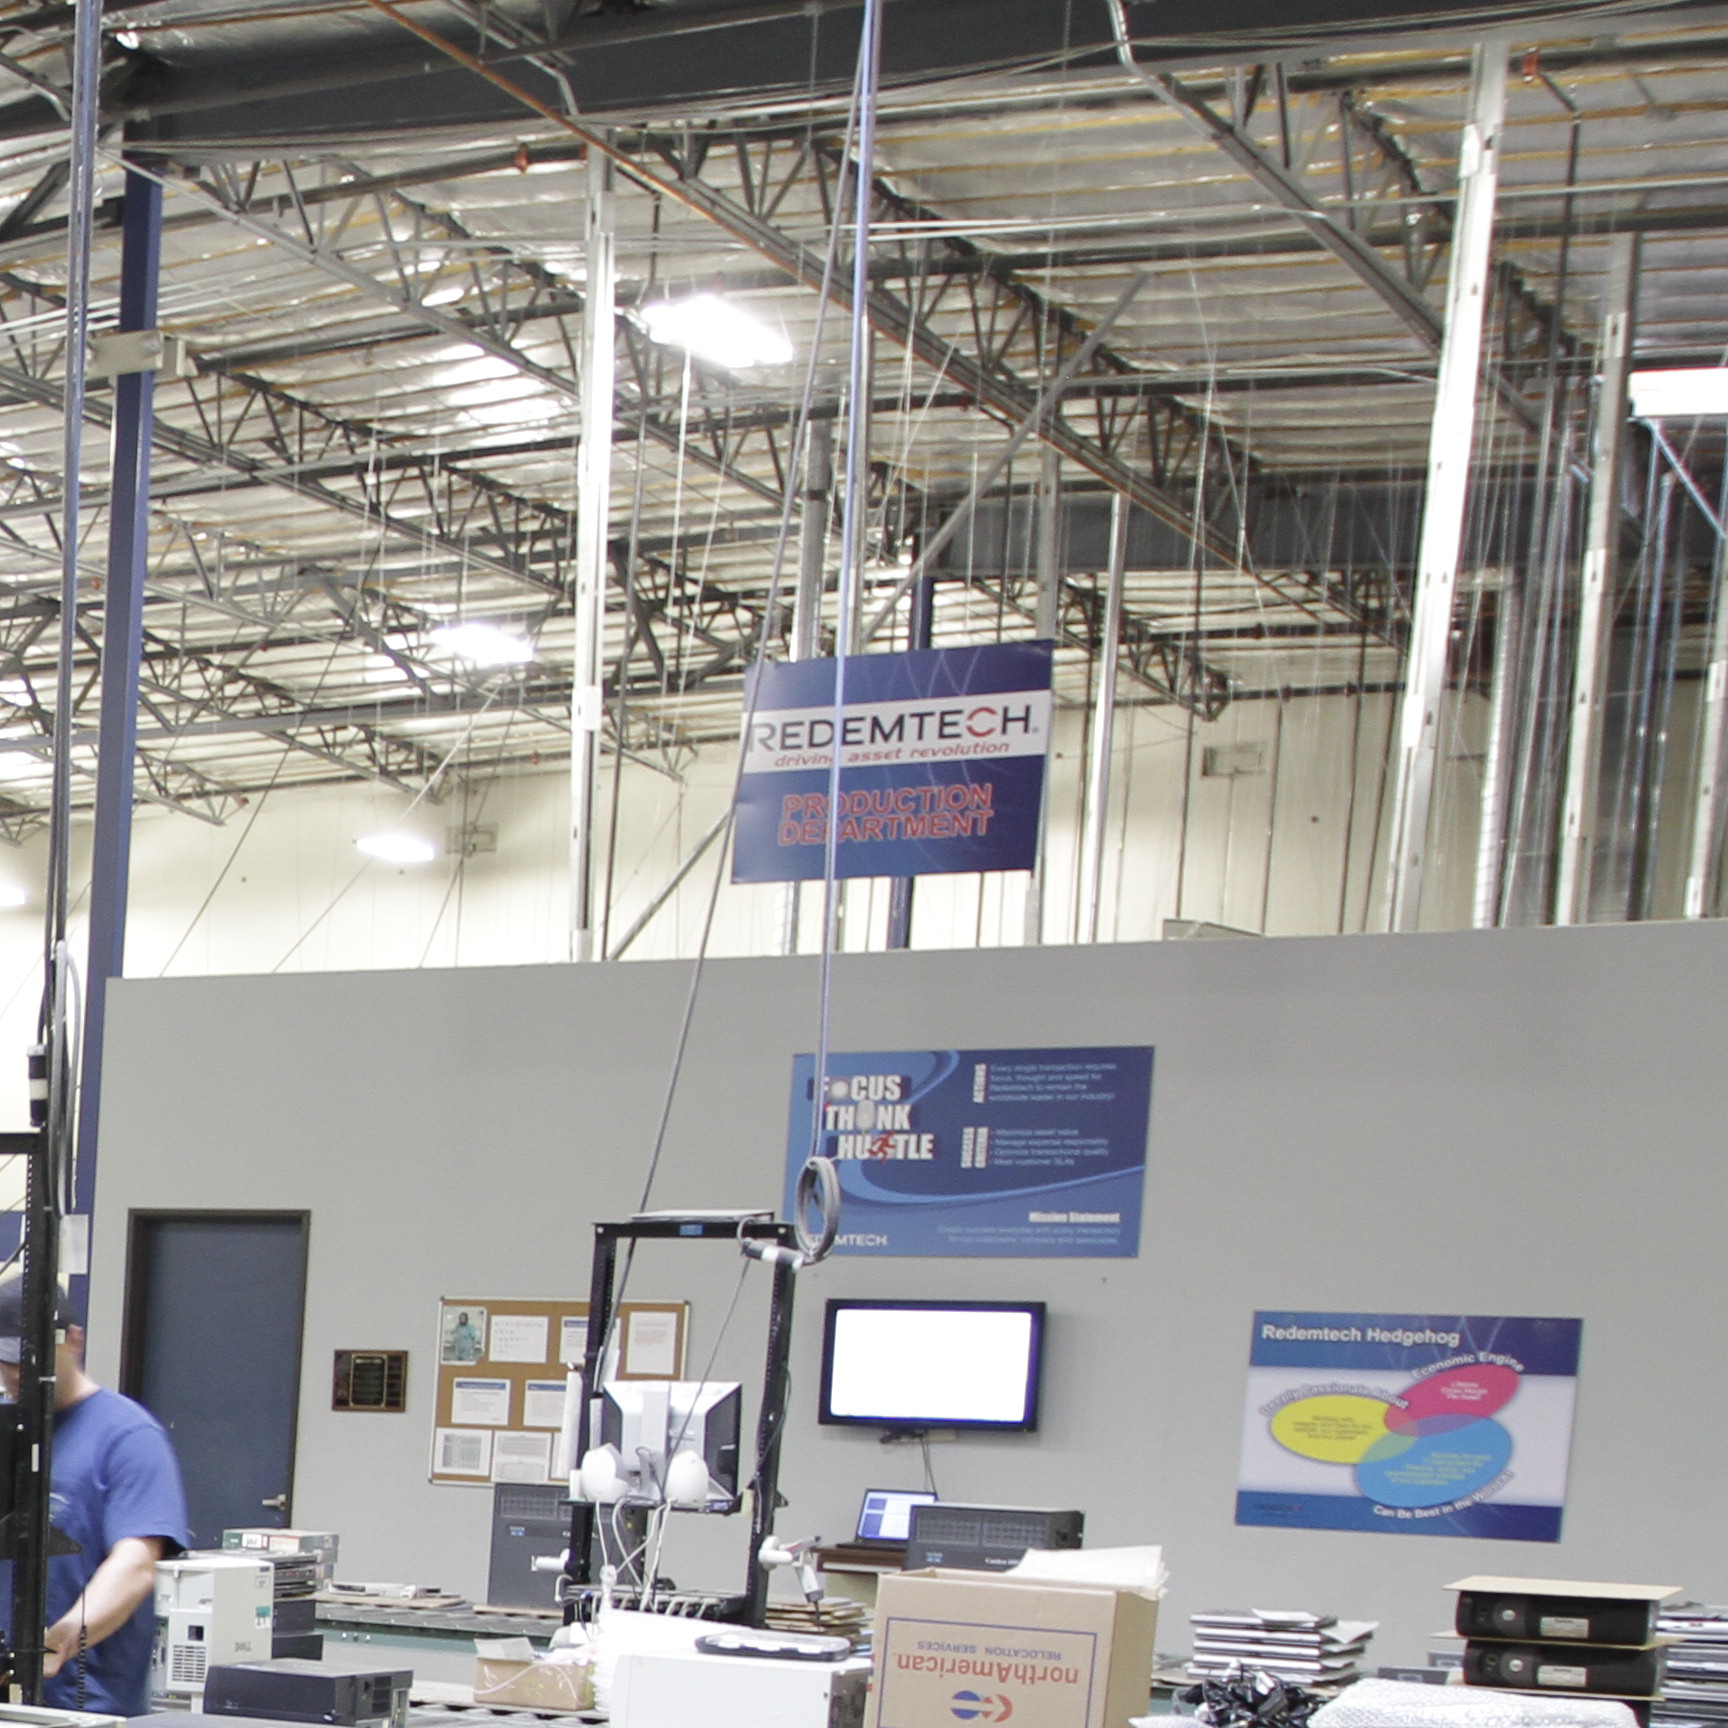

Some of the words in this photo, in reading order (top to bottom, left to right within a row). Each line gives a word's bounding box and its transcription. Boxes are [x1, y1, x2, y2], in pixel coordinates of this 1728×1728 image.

[747, 704, 1032, 752] REDEMTECH
[847, 748, 902, 763] asset
[909, 742, 1011, 760] revolution
[1261, 1323, 1361, 1343] Redemtech
[1366, 1325, 1461, 1348] Hedgehog
[1411, 1352, 1476, 1380] Economic
[1478, 1351, 1525, 1373] Engine
[1372, 1504, 1395, 1518] Can
[1397, 1507, 1413, 1519] Be
[1415, 1506, 1441, 1519] Best
[917, 1640, 979, 1655] SERVICES
[983, 1645, 1062, 1661] RELOCATION
[897, 1653, 1079, 1685] northAmerican
